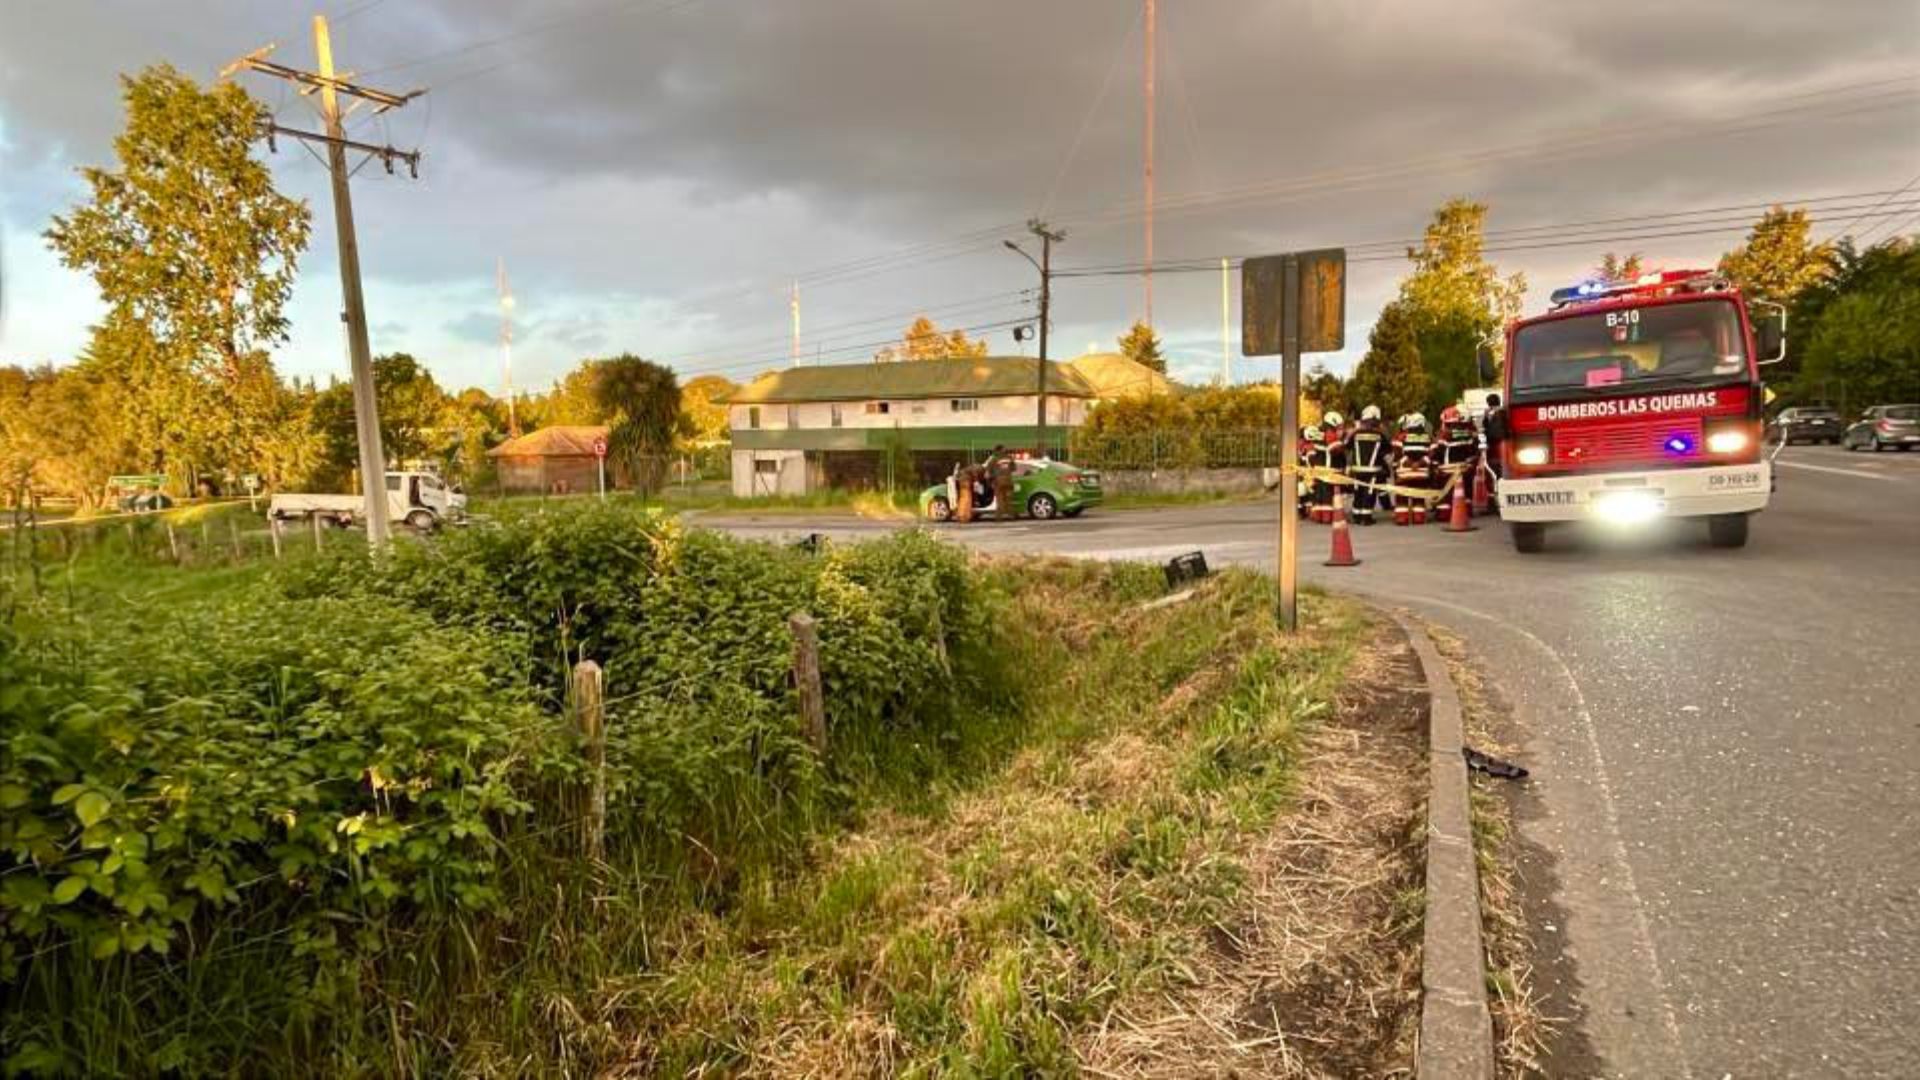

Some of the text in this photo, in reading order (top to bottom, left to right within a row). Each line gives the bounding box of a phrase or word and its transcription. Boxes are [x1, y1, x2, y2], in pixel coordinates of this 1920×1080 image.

[1606, 310, 1639, 327] B-10
[1537, 392, 1716, 421] BOMBEROS LAS QUEMAS
[1506, 491, 1575, 506] RENAULT
